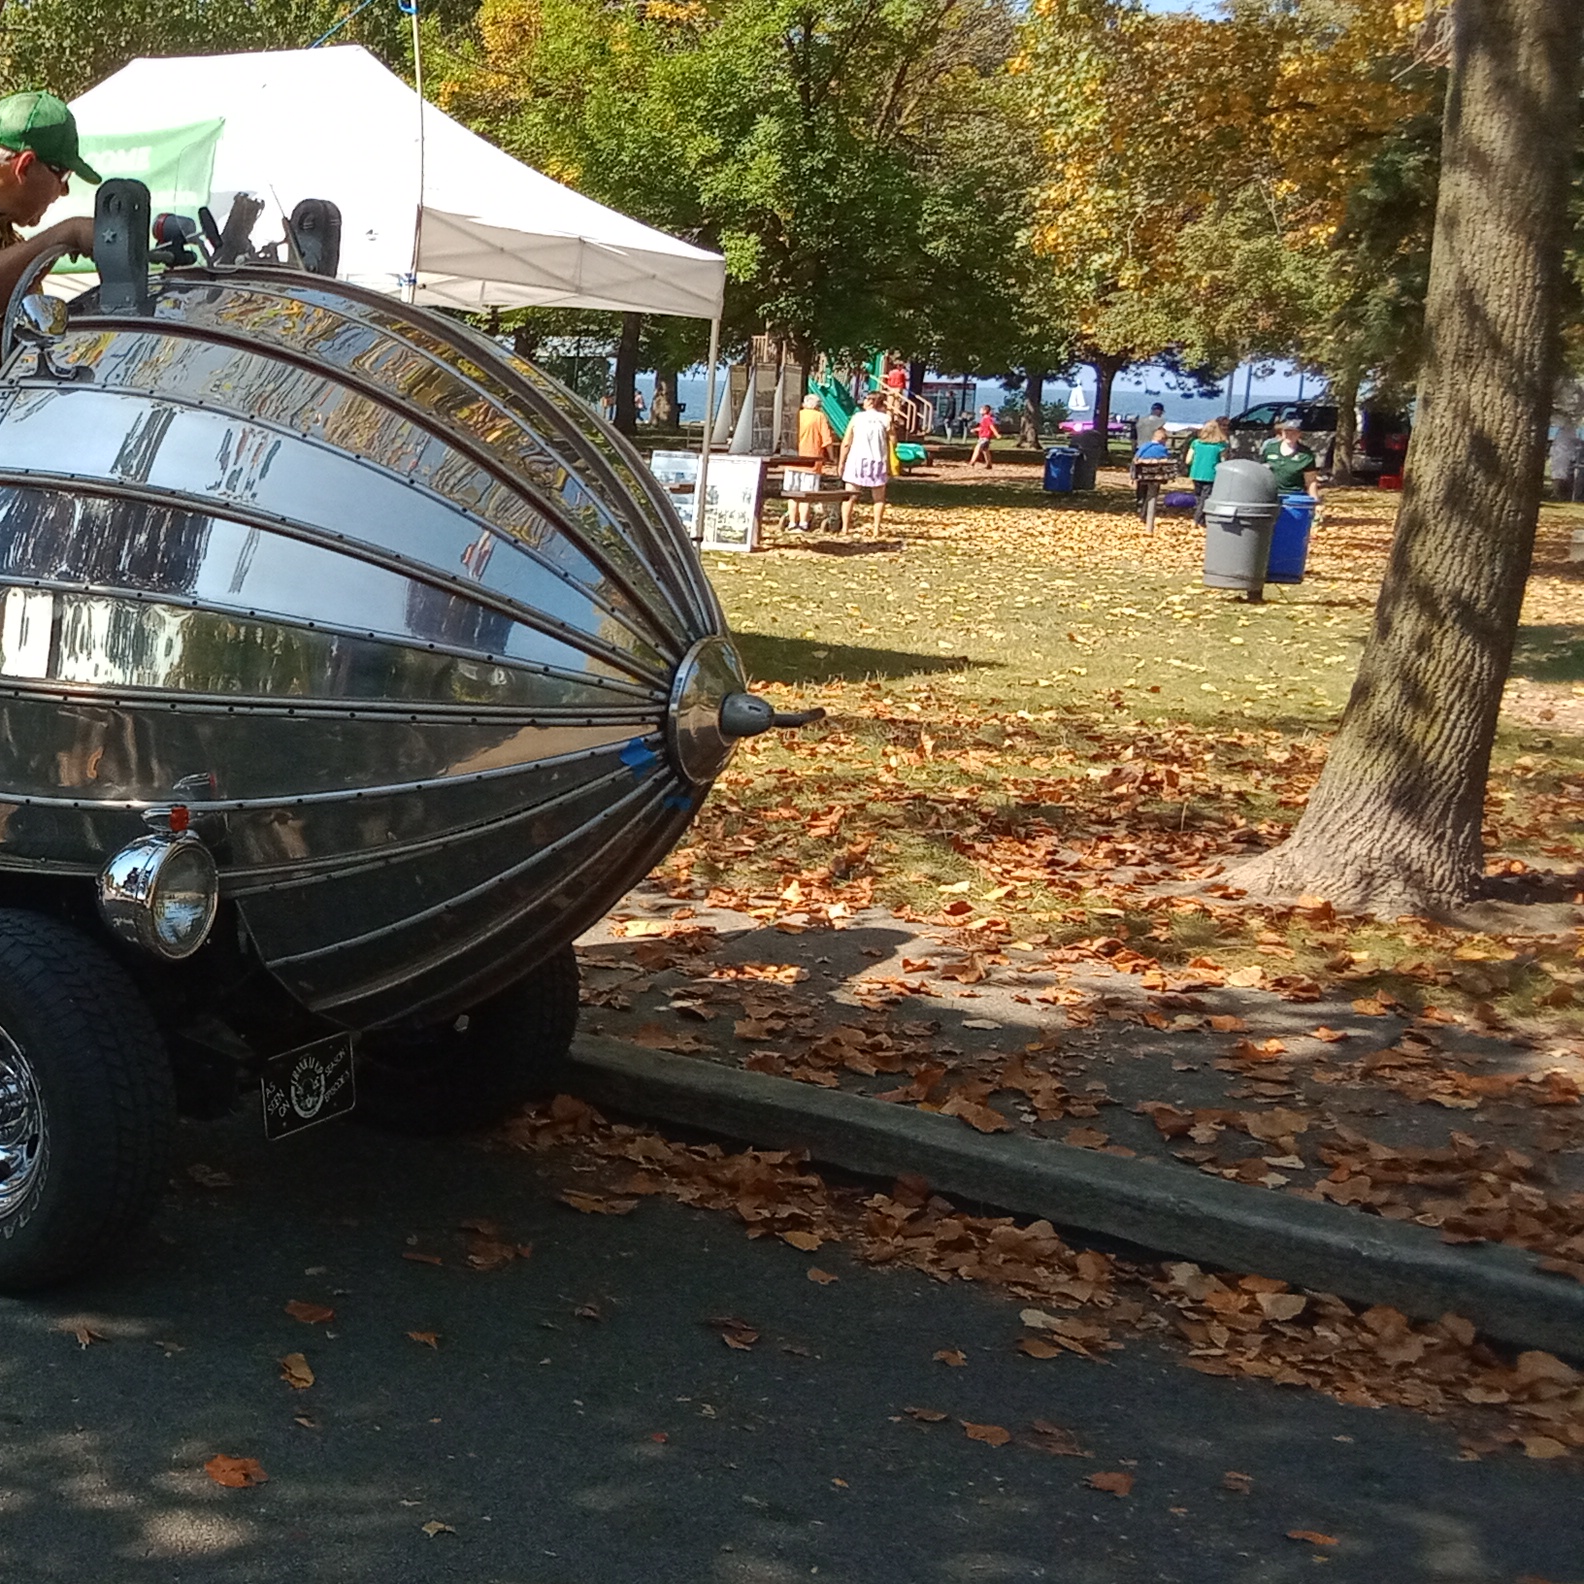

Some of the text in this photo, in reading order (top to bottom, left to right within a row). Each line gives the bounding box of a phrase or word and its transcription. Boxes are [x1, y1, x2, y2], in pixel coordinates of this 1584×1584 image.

[265, 1081, 276, 1098] AS
[267, 1088, 284, 1115] SEEN
[278, 1100, 290, 1117] ON
